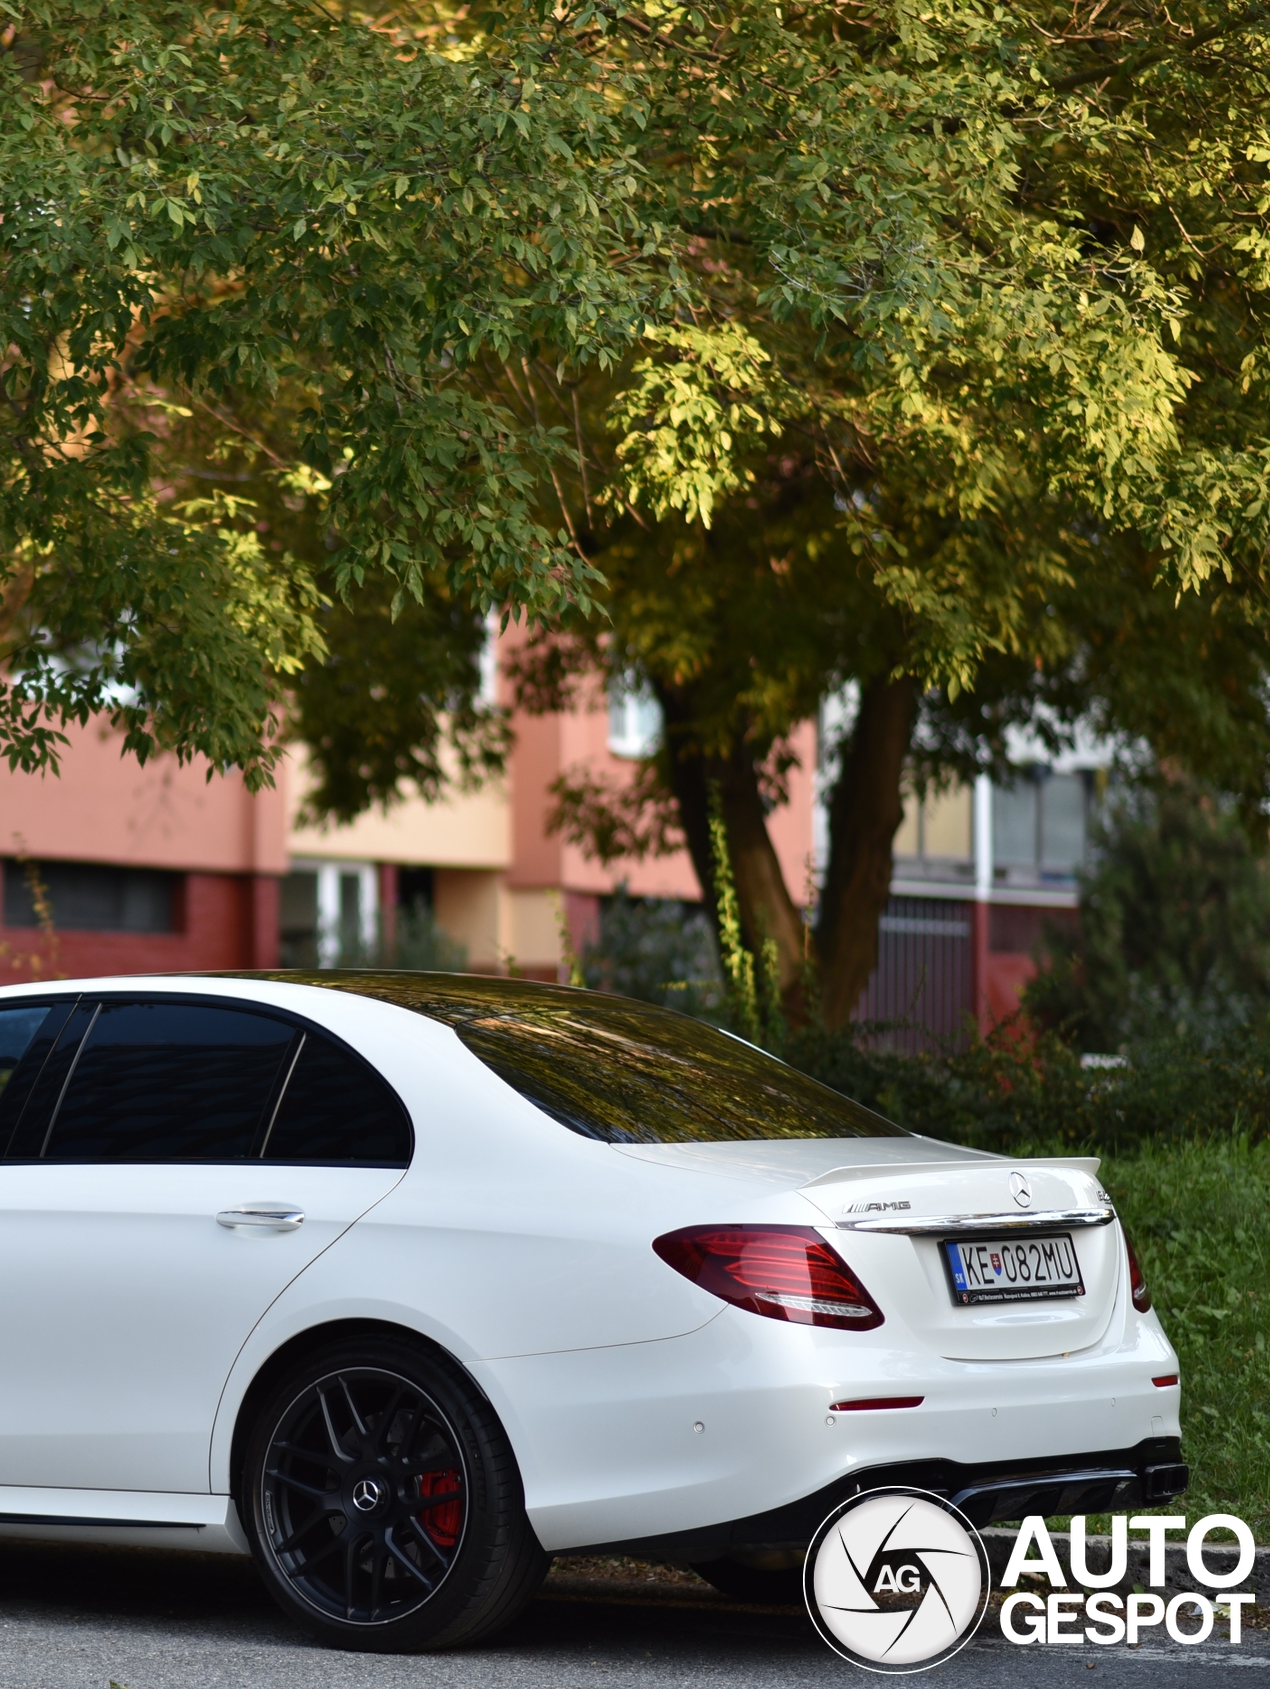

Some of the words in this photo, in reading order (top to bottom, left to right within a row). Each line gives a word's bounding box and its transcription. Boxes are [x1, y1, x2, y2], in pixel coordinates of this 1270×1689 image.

[867, 1201, 911, 1211] AMG
[961, 1246, 995, 1285] KE
[1001, 1242, 1073, 1282] 082MU
[955, 1273, 965, 1283] SK
